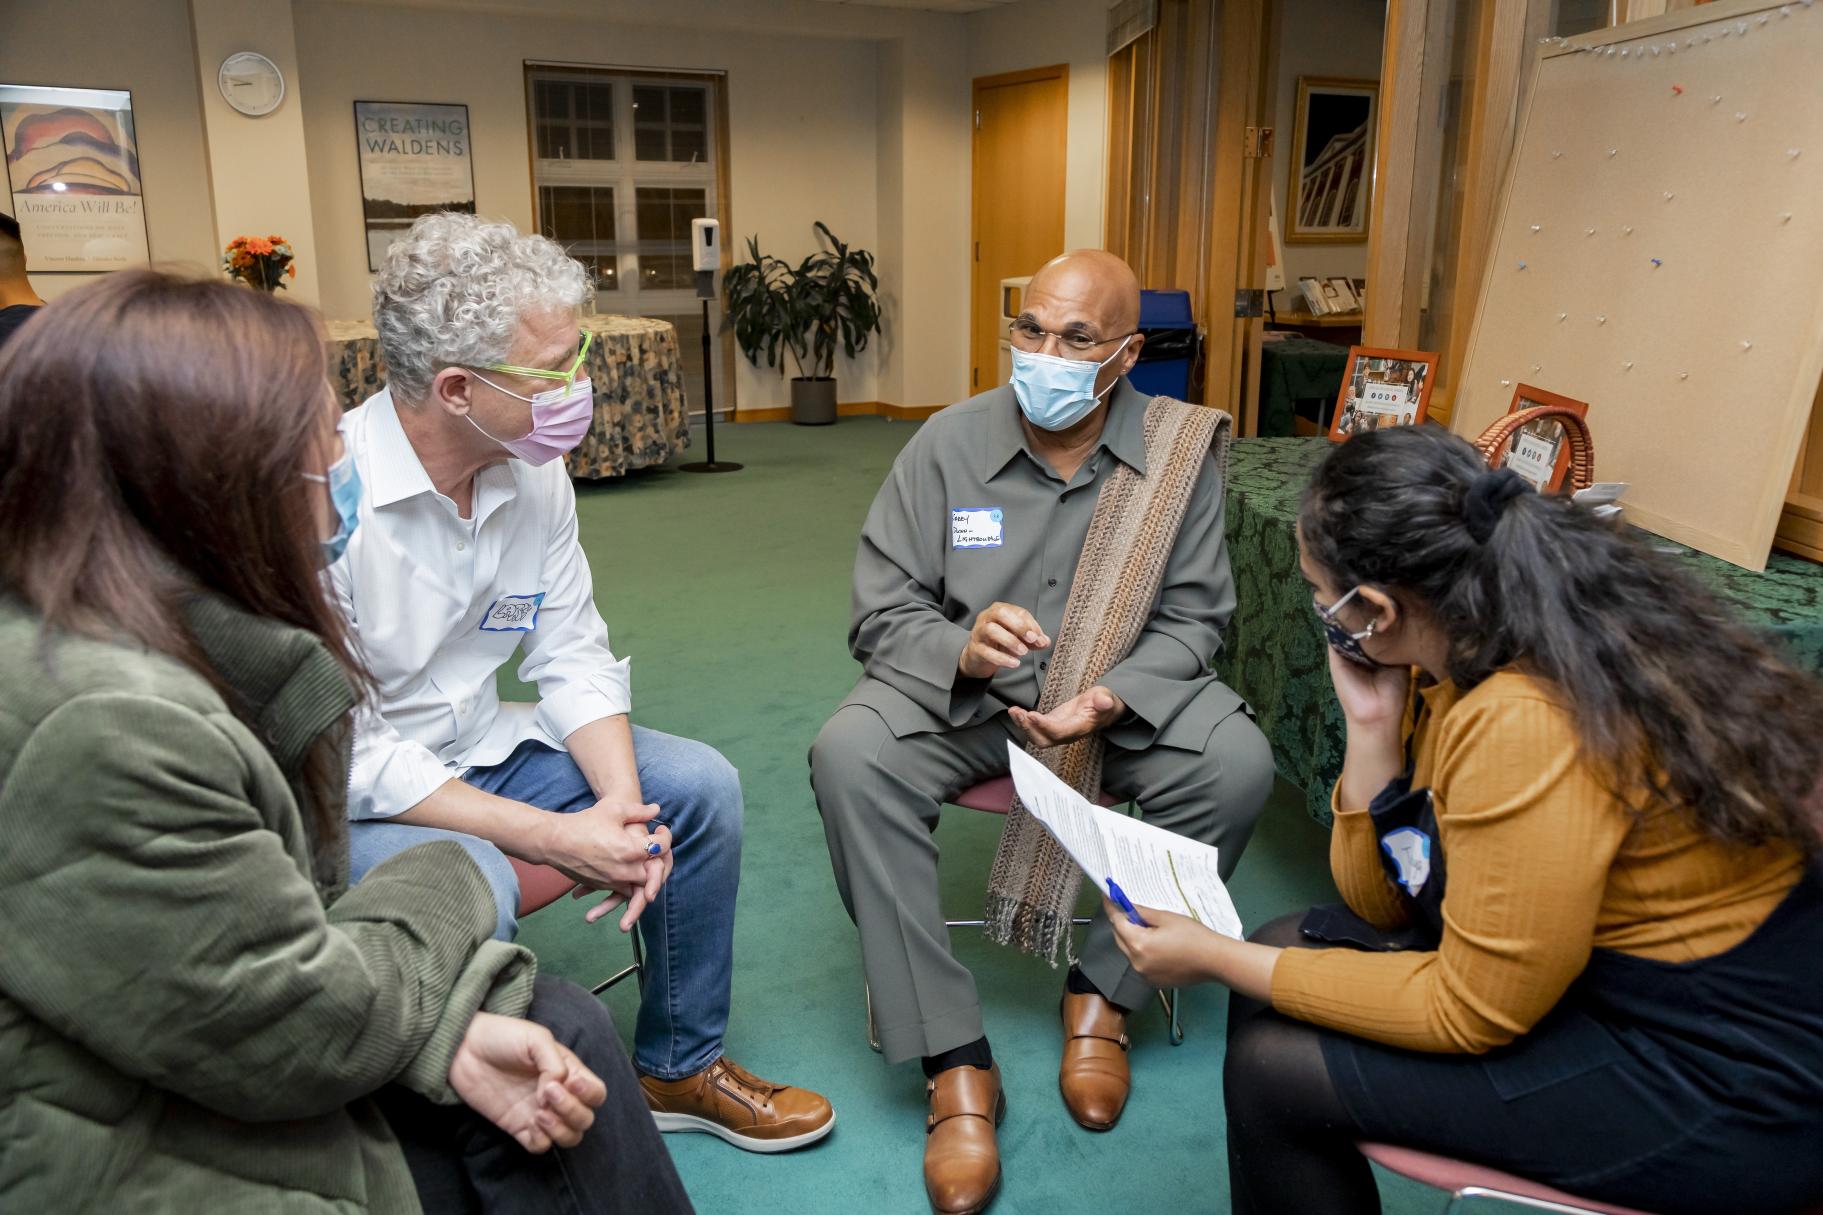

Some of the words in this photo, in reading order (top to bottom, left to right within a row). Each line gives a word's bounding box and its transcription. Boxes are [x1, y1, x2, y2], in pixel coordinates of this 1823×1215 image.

[362, 117, 464, 136] CREATING
[366, 138, 464, 156] WALDENS
[20, 199, 77, 213] America
[80, 200, 110, 214] Will
[115, 200, 137, 215] Be!
